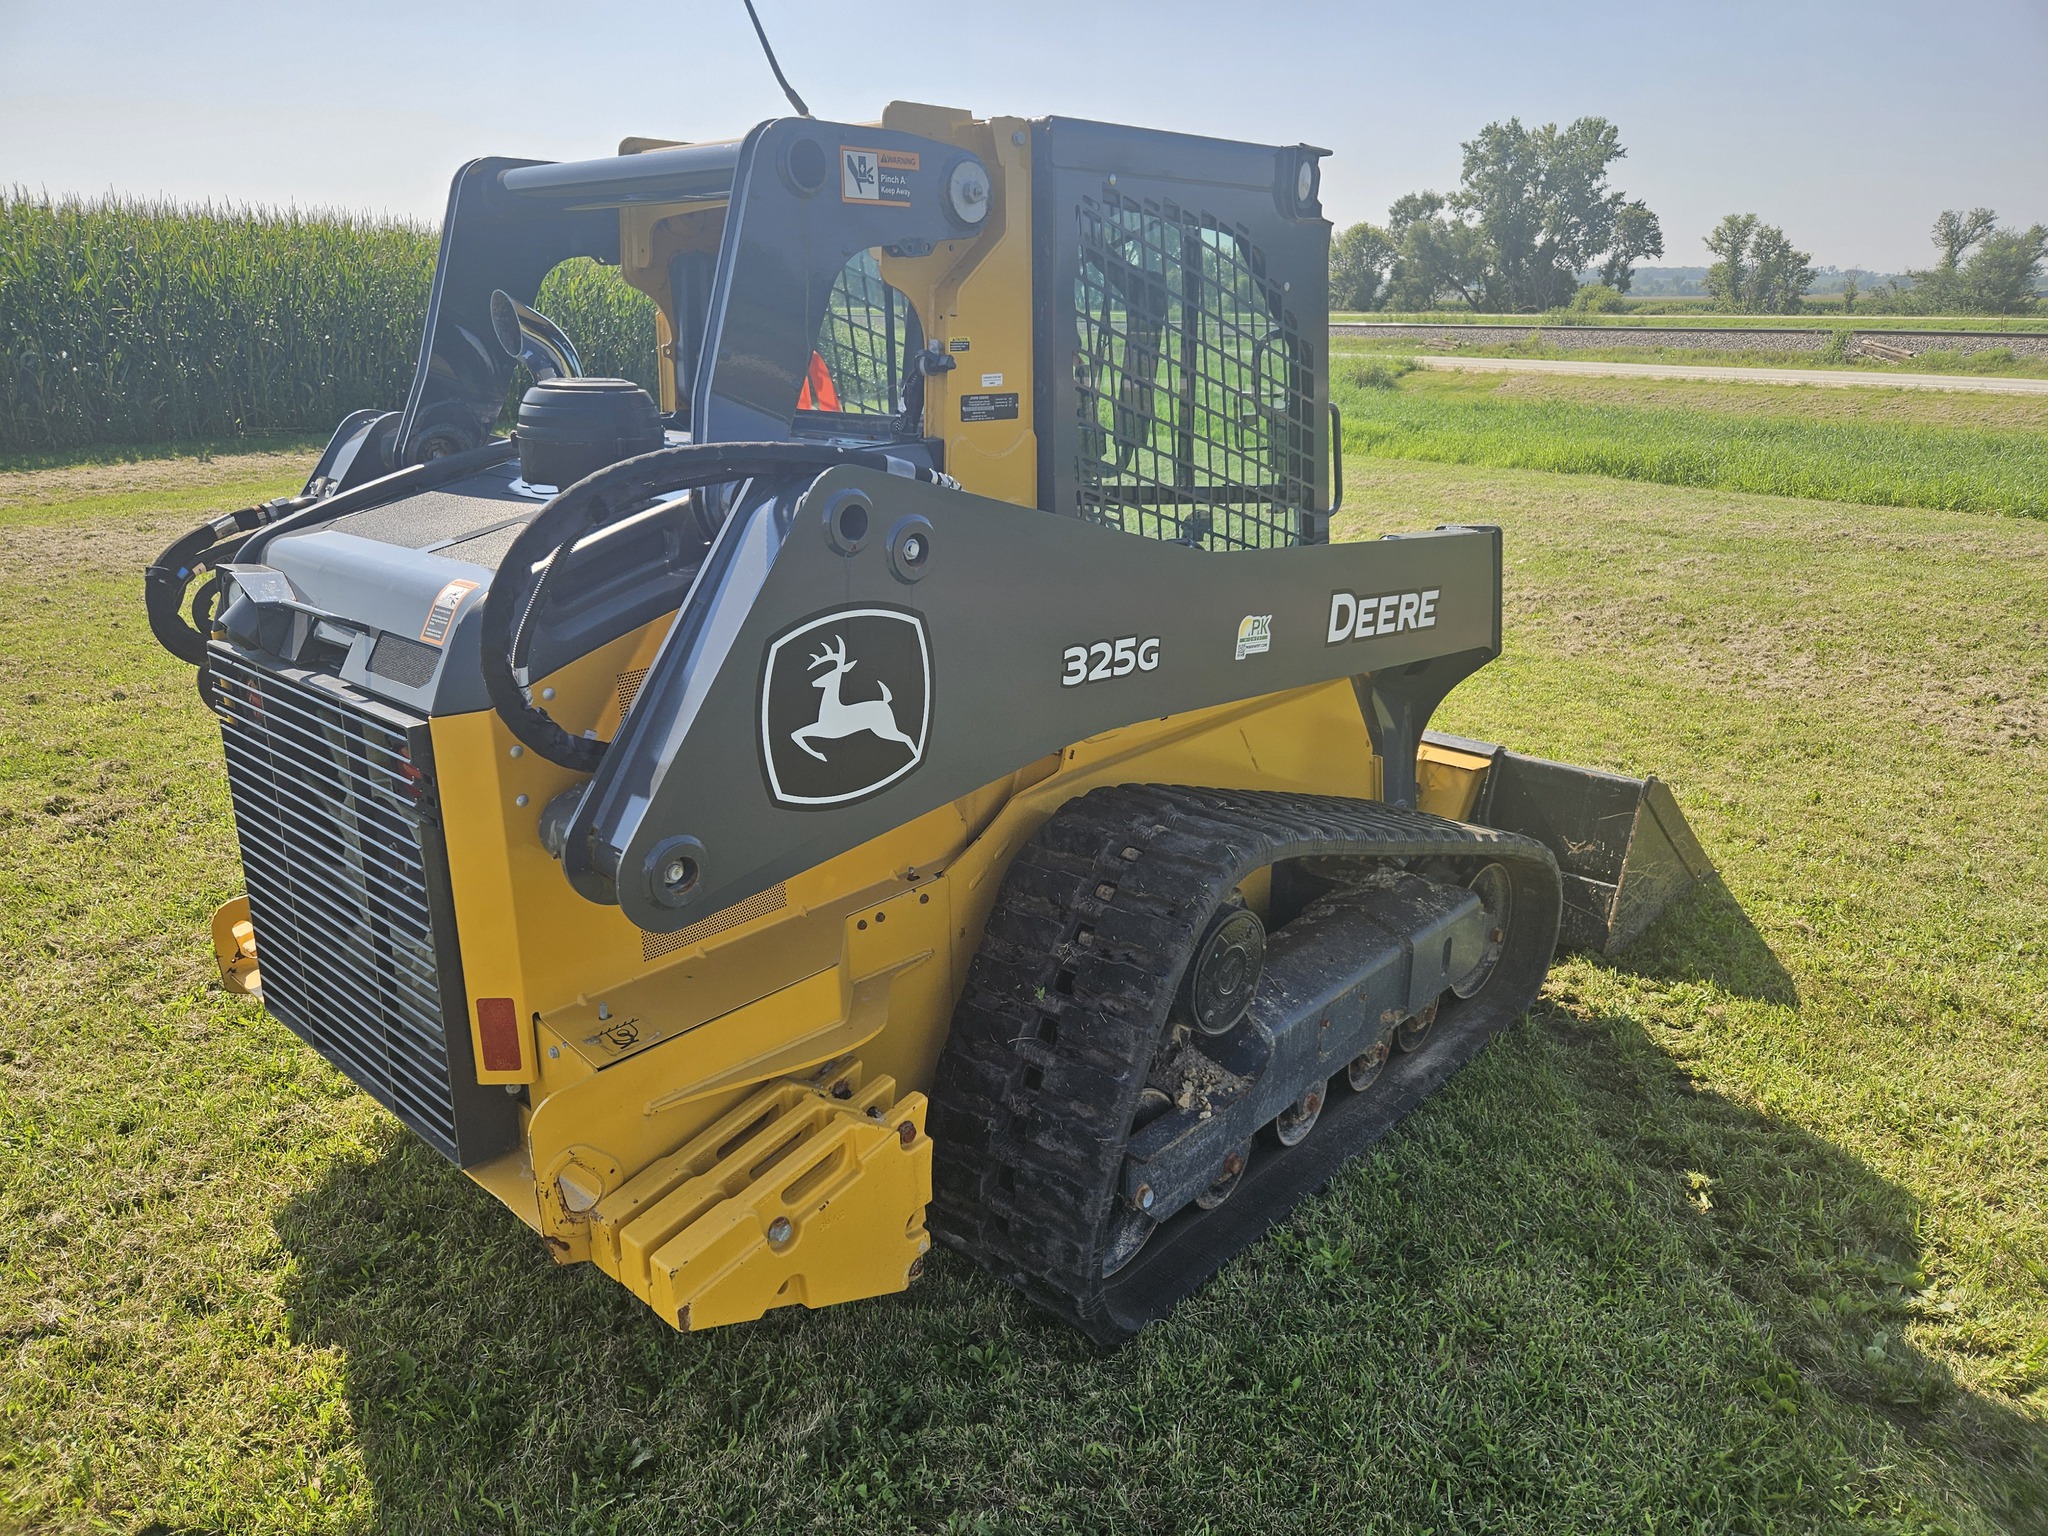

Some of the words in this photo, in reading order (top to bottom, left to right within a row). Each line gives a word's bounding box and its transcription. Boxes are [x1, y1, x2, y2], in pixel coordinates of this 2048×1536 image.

[887, 156, 916, 165] WARNING
[880, 174, 899, 184] Pinch
[880, 186, 895, 195] Keep
[896, 187, 910, 197] Away
[1327, 589, 1440, 643] DEERE
[1062, 637, 1160, 686] 325G
